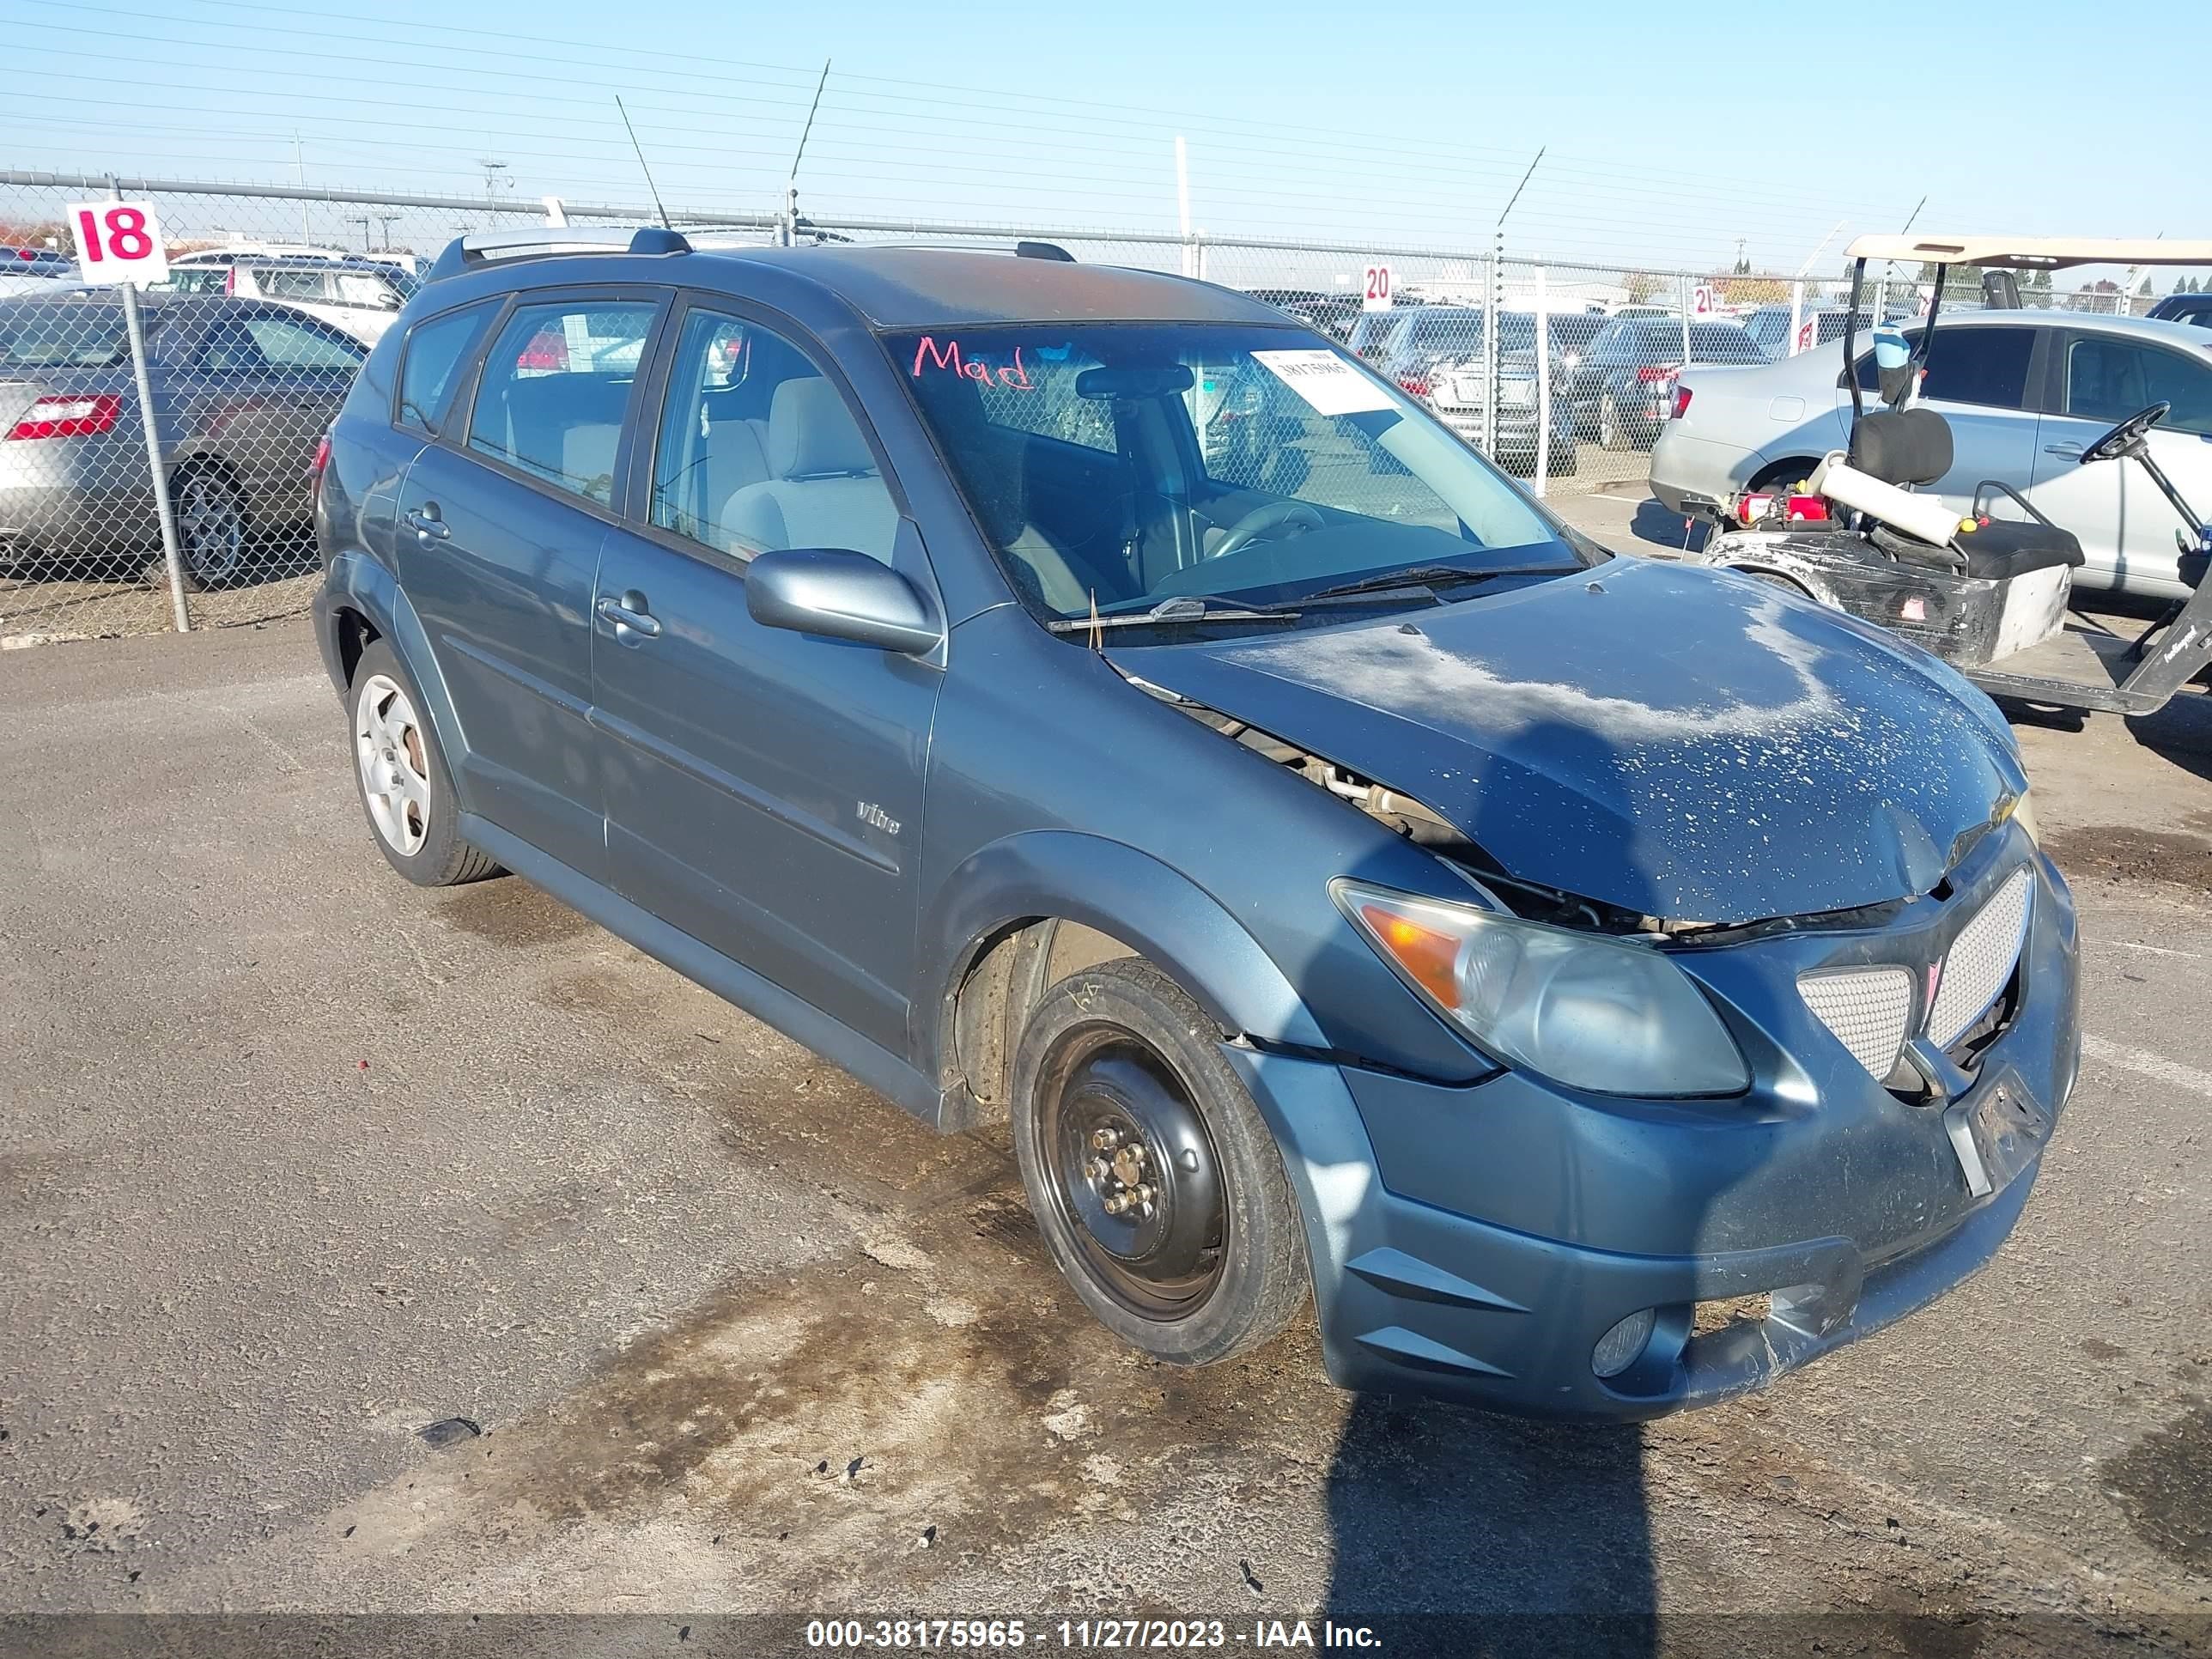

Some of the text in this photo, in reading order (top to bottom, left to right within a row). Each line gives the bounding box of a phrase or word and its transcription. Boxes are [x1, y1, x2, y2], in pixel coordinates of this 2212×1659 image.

[79, 207, 153, 262] 18
[1367, 268, 1389, 299] 20
[1696, 288, 1713, 313] 21
[913, 336, 1036, 390] Mad
[1278, 362, 1348, 377] 38175965
